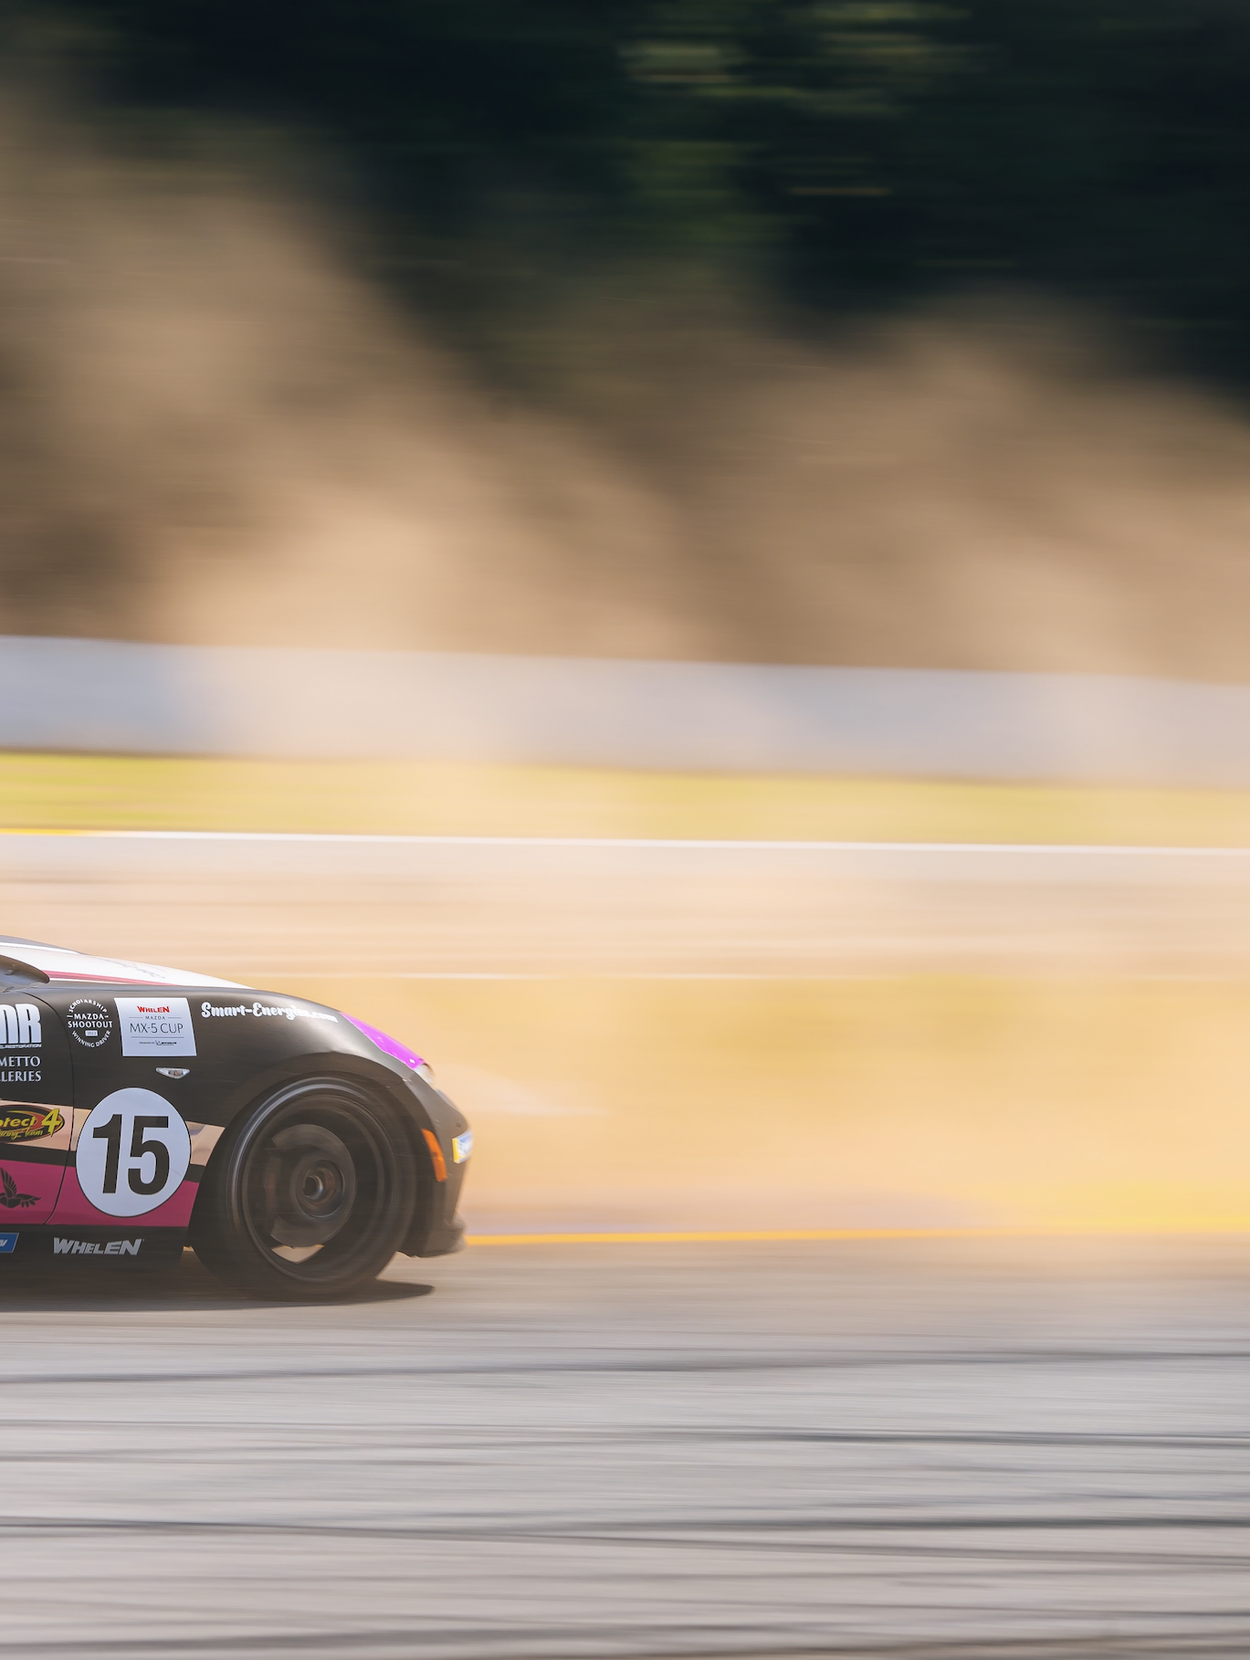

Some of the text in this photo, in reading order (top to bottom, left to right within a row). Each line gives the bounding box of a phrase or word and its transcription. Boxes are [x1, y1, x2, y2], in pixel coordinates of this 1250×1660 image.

[68, 998, 107, 1013] SCHOLARSHIP
[136, 1005, 170, 1013] WHELEN
[67, 1020, 112, 1028] SHOOTOUT
[130, 1023, 183, 1034] MX-5 CUP
[72, 1030, 111, 1048] WINNING DRIVER
[41, 1108, 61, 1137] 4
[92, 1114, 170, 1195] 15
[53, 1237, 142, 1255] WHELEN
